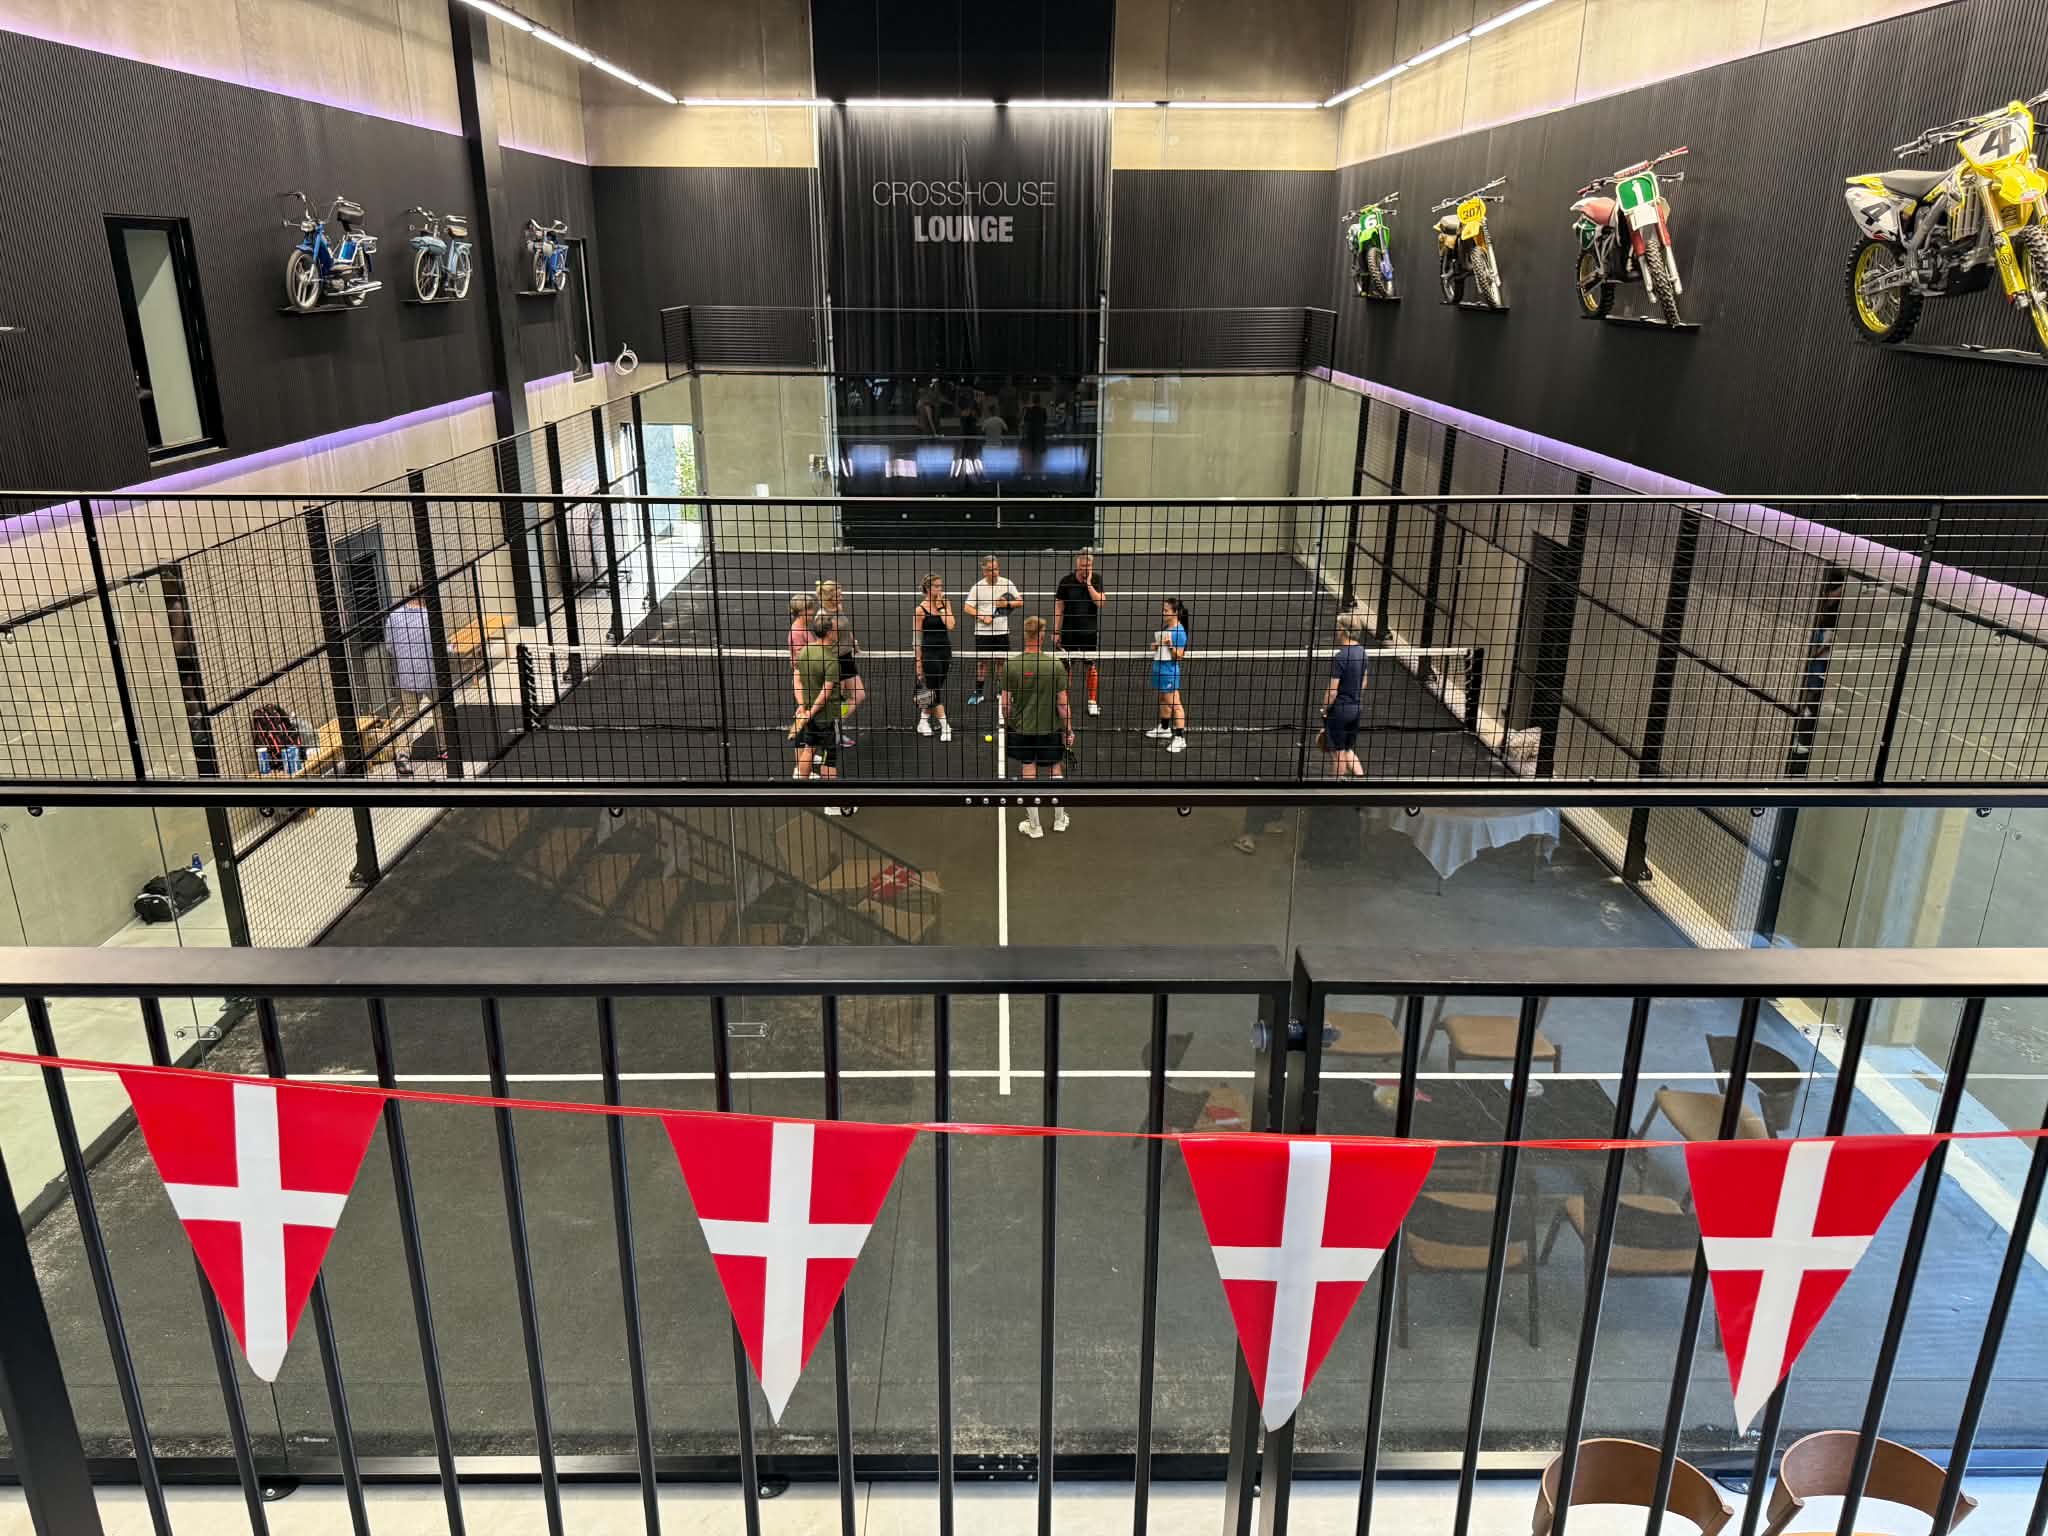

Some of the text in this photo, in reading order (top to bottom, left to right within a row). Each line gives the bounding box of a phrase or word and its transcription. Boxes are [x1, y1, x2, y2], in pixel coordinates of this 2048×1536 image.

[1979, 123, 2017, 158] 4
[872, 181, 1057, 206] CROSSHOUSE
[1631, 179, 1645, 203] 1
[1365, 214, 1378, 230] 6
[1860, 201, 1892, 226] 4
[913, 215, 1014, 242] LOUNGE
